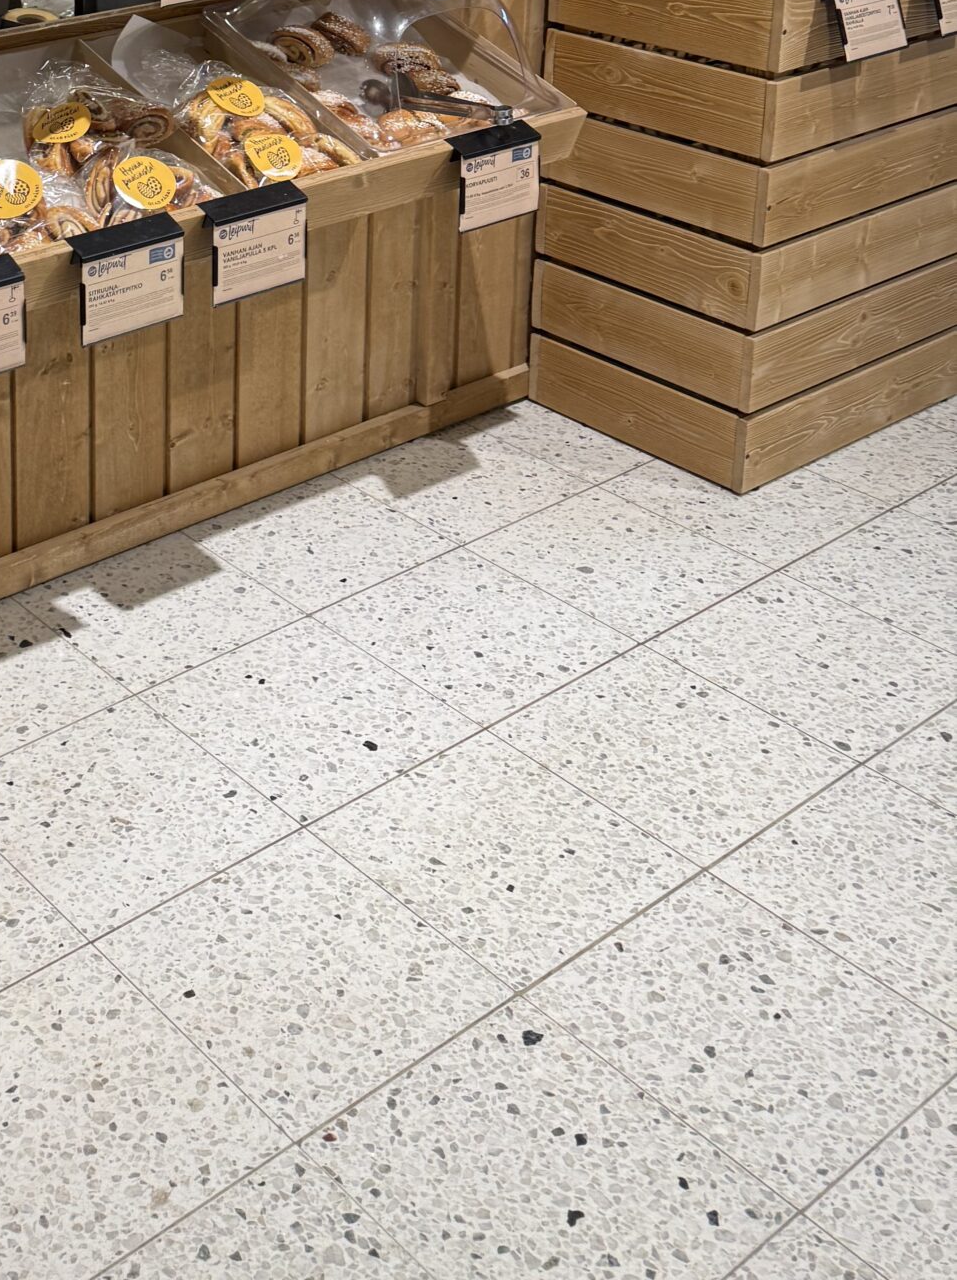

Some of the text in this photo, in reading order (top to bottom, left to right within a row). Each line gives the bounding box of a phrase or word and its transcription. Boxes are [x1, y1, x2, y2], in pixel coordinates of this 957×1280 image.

[520, 168, 530, 179] 36
[288, 234, 294, 245] 6
[98, 254, 132, 277] Leipurit
[160, 270, 167, 281] 6
[2, 313, 10, 325] 6
